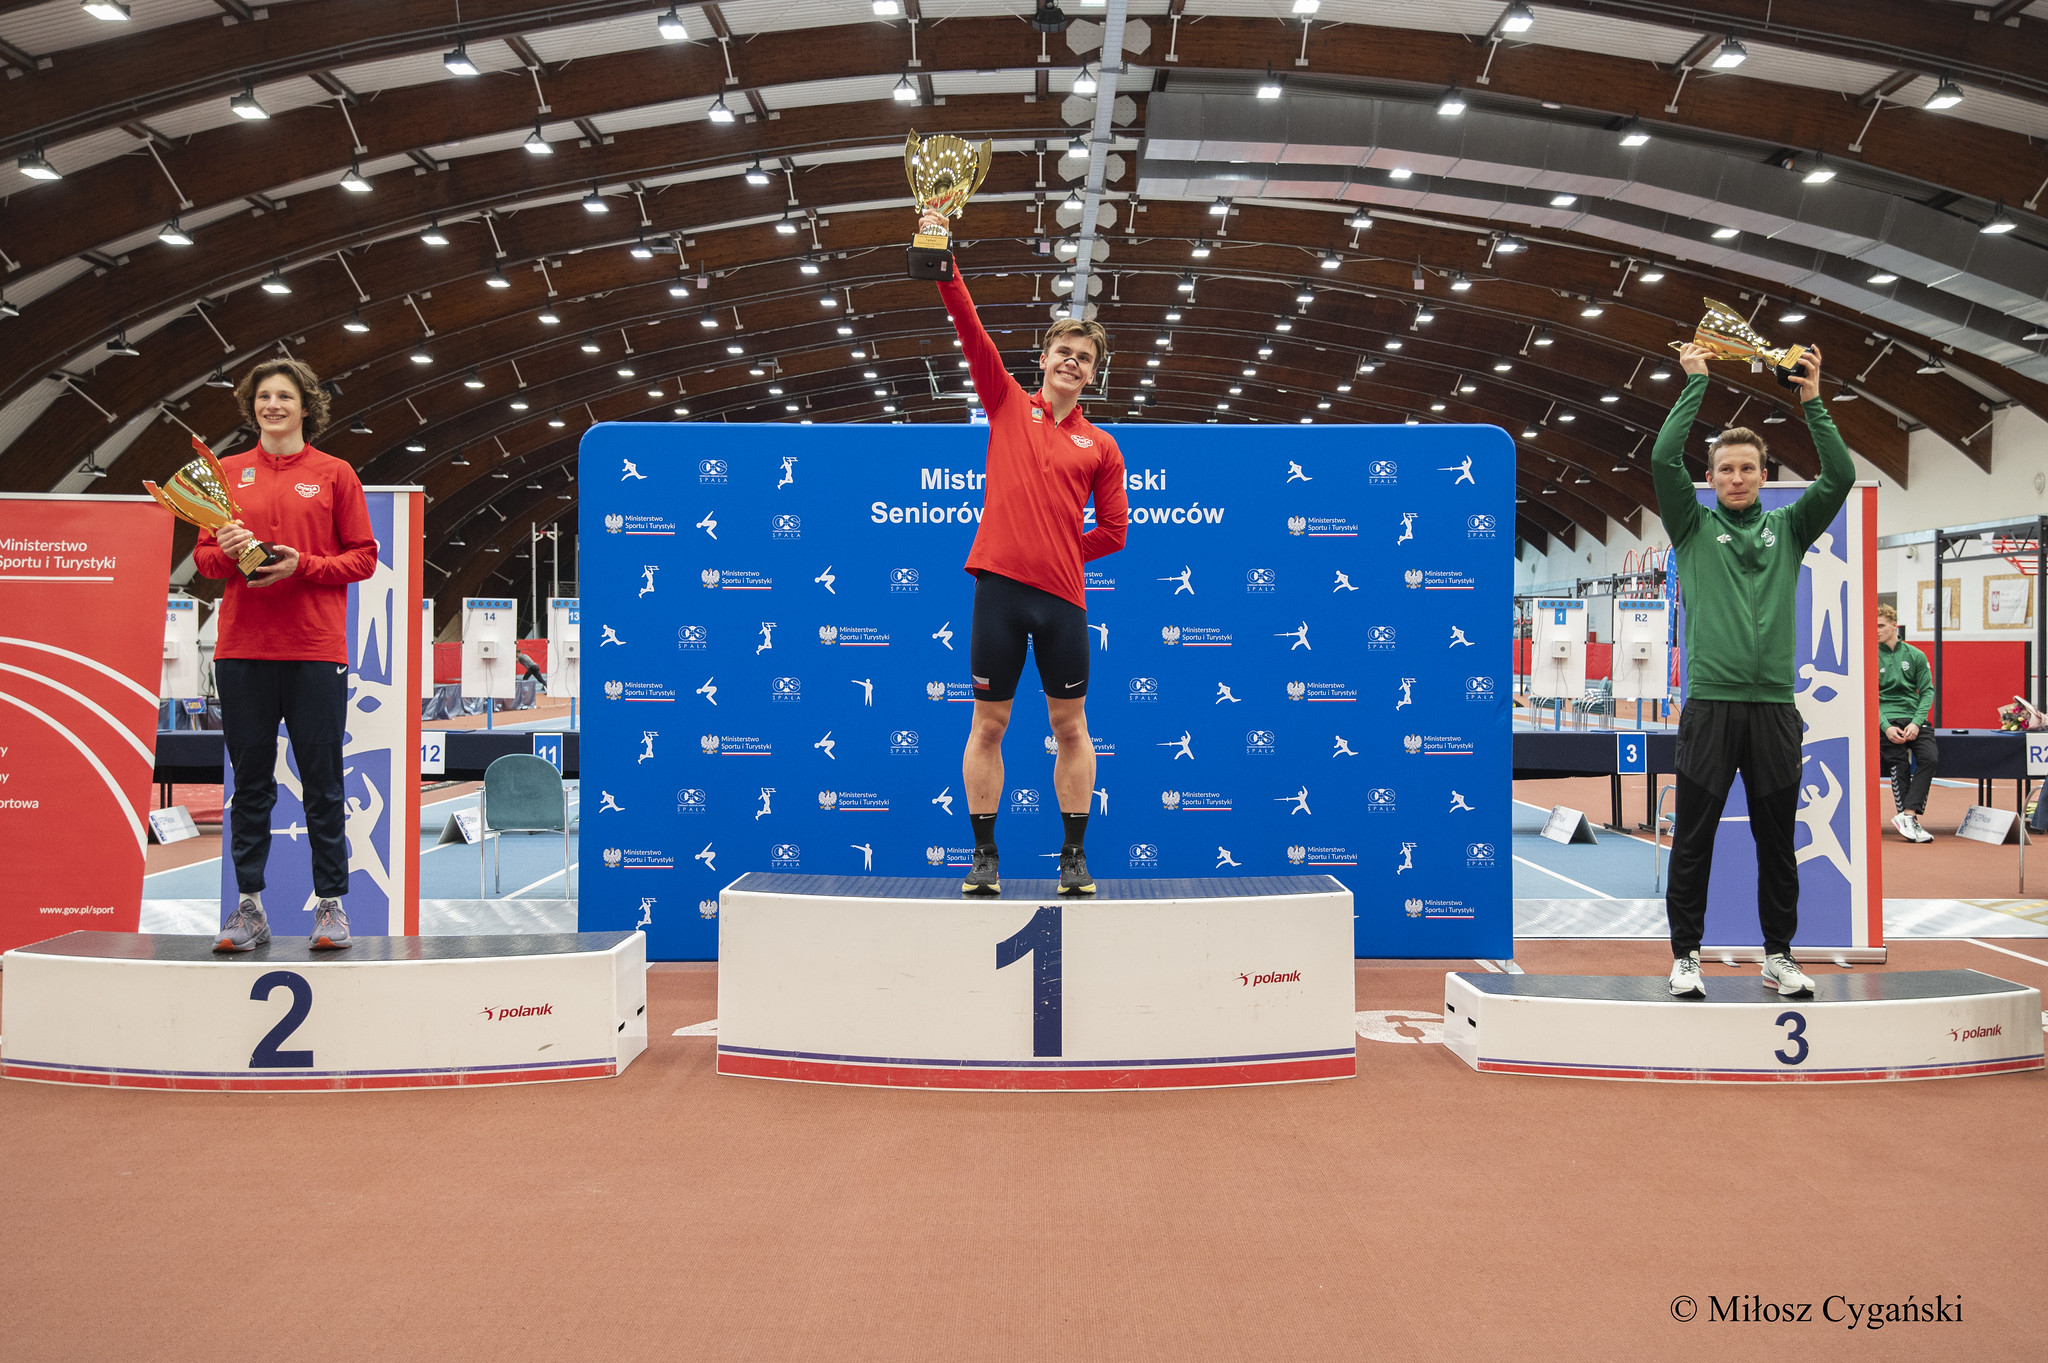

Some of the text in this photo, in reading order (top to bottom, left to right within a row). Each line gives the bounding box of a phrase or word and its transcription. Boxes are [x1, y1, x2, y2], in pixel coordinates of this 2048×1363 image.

[921, 468, 1166, 490] Mistr lski
[625, 523, 645, 531] Sportu
[649, 522, 676, 531] Turystyki
[1308, 525, 1328, 533] Sportu
[1332, 524, 1359, 533] Turystyki
[0, 538, 88, 552] Ministerstwo
[0, 555, 117, 571] Sportu i Turystyki
[722, 578, 742, 586] Sportu
[746, 577, 773, 586] Turystyki
[1089, 578, 1116, 586] Turystyki
[1424, 578, 1444, 586] Sportu
[1448, 577, 1475, 586] Turystyki
[484, 612, 496, 621] 14
[569, 611, 580, 621] 13
[1558, 612, 1563, 622] 1
[1635, 613, 1648, 622] R2
[839, 634, 859, 642] Sportu
[863, 633, 890, 642] Turystyki
[1182, 634, 1202, 642] Sportu
[1206, 633, 1233, 642] Turystyki
[625, 690, 645, 698] Sportu
[649, 689, 676, 698] Turystyki
[947, 689, 966, 697] Sportu
[1307, 690, 1327, 698] Sportu
[1331, 689, 1358, 698] Turystyki
[721, 744, 741, 752] Sportu
[745, 743, 772, 752] Turystyki
[1094, 743, 1116, 751] rystyki
[1423, 743, 1443, 751] Sportu
[1447, 742, 1474, 751] Turystyki
[421, 745, 440, 762] 12
[538, 746, 557, 765] 11
[1626, 744, 1637, 763] 3
[839, 799, 859, 807] Sportu
[863, 798, 890, 807] Turystyki
[1182, 799, 1202, 807] Sportu
[1206, 798, 1233, 807] Turystyki
[623, 857, 643, 865] Sportu
[647, 856, 674, 865] Turystyki
[947, 854, 966, 862] Sportu
[1307, 854, 1327, 862] Sportu
[1331, 853, 1358, 862] Turystyki
[39, 905, 115, 915] www.gov.pl/sport
[1425, 907, 1445, 915] Sportu
[1449, 906, 1476, 915] Turystyki
[996, 906, 1062, 1058] 1
[249, 971, 314, 1068] 2
[1774, 1012, 1809, 1066] 3
